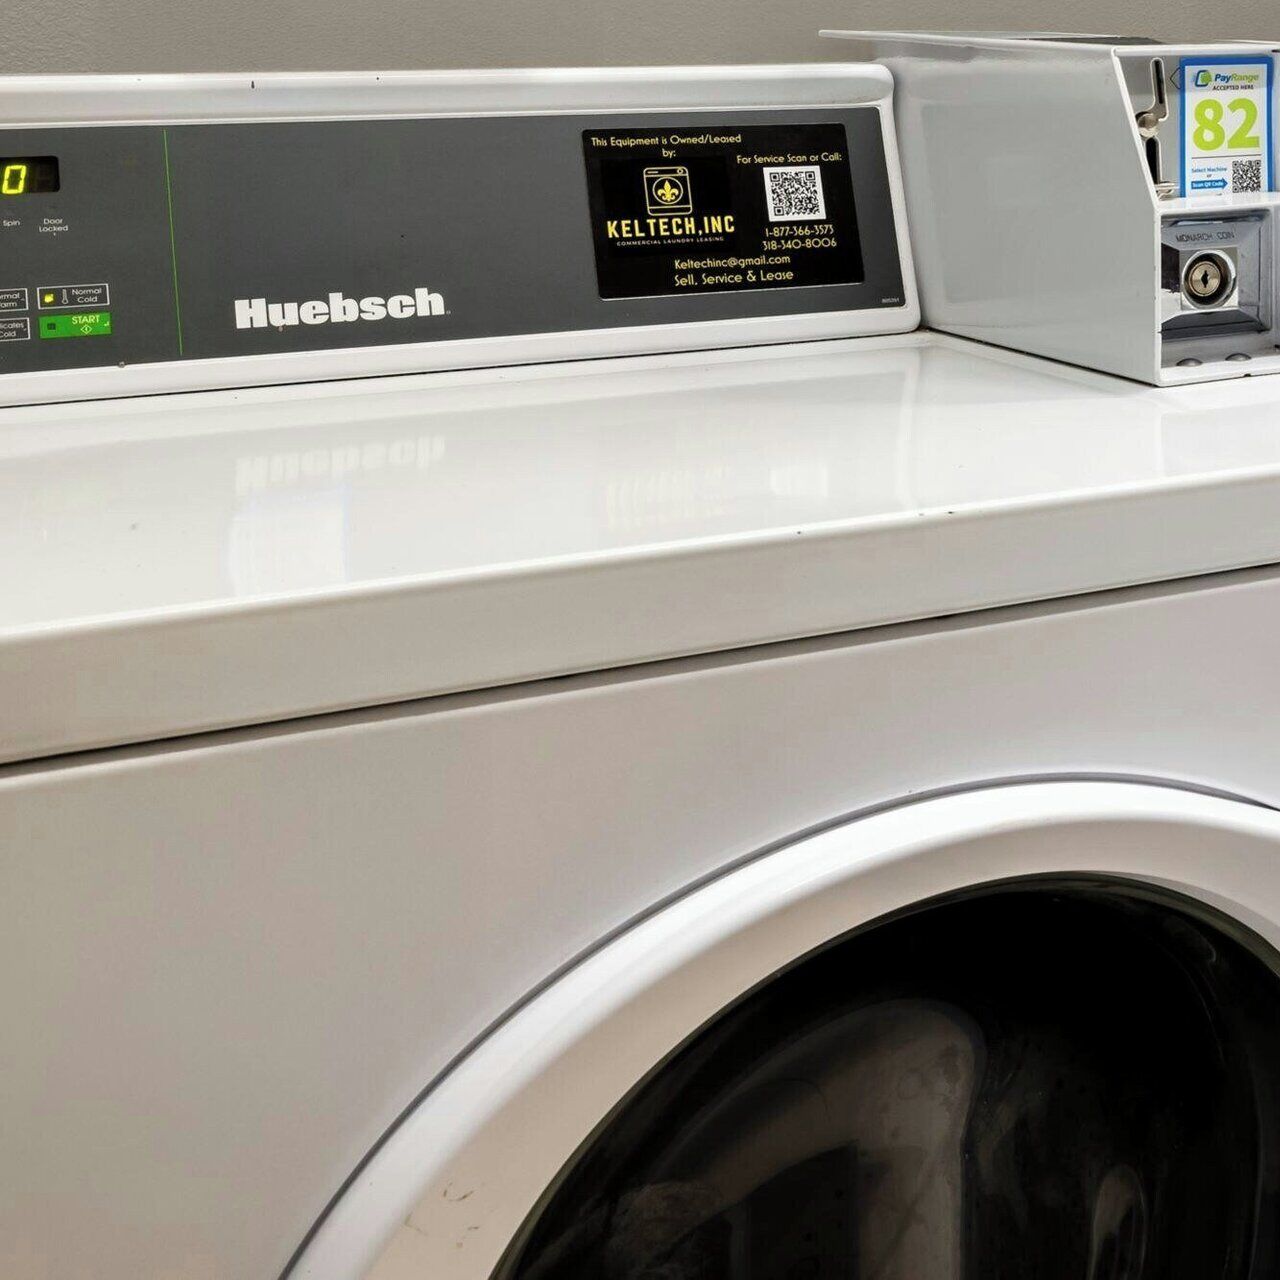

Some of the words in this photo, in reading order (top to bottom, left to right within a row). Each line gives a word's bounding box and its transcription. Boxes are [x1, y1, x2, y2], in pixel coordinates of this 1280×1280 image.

[1214, 73, 1259, 83] PayRange
[1192, 97, 1260, 151] 82
[590, 137, 608, 147] This
[610, 136, 659, 147] Equipment
[661, 136, 667, 145] is
[669, 134, 742, 145] Owned/Leased
[661, 148, 676, 158] by:
[736, 154, 751, 164] For
[753, 154, 785, 164] Service
[786, 153, 807, 163] Scan
[809, 154, 818, 162] or
[820, 152, 842, 162] Call:
[39, 224, 69, 232] Locked
[607, 215, 735, 239] KELTECH,INC
[765, 224, 834, 238] 1-877-366-3573
[762, 237, 837, 251] 318-340-8006
[674, 255, 791, 270] Keltechinc@gmail.com
[702, 273, 743, 285] Service
[746, 270, 756, 282] &
[760, 270, 794, 281] Lease
[71, 287, 102, 295] Normal
[234, 287, 446, 330] Huebsch
[72, 315, 100, 325] START
